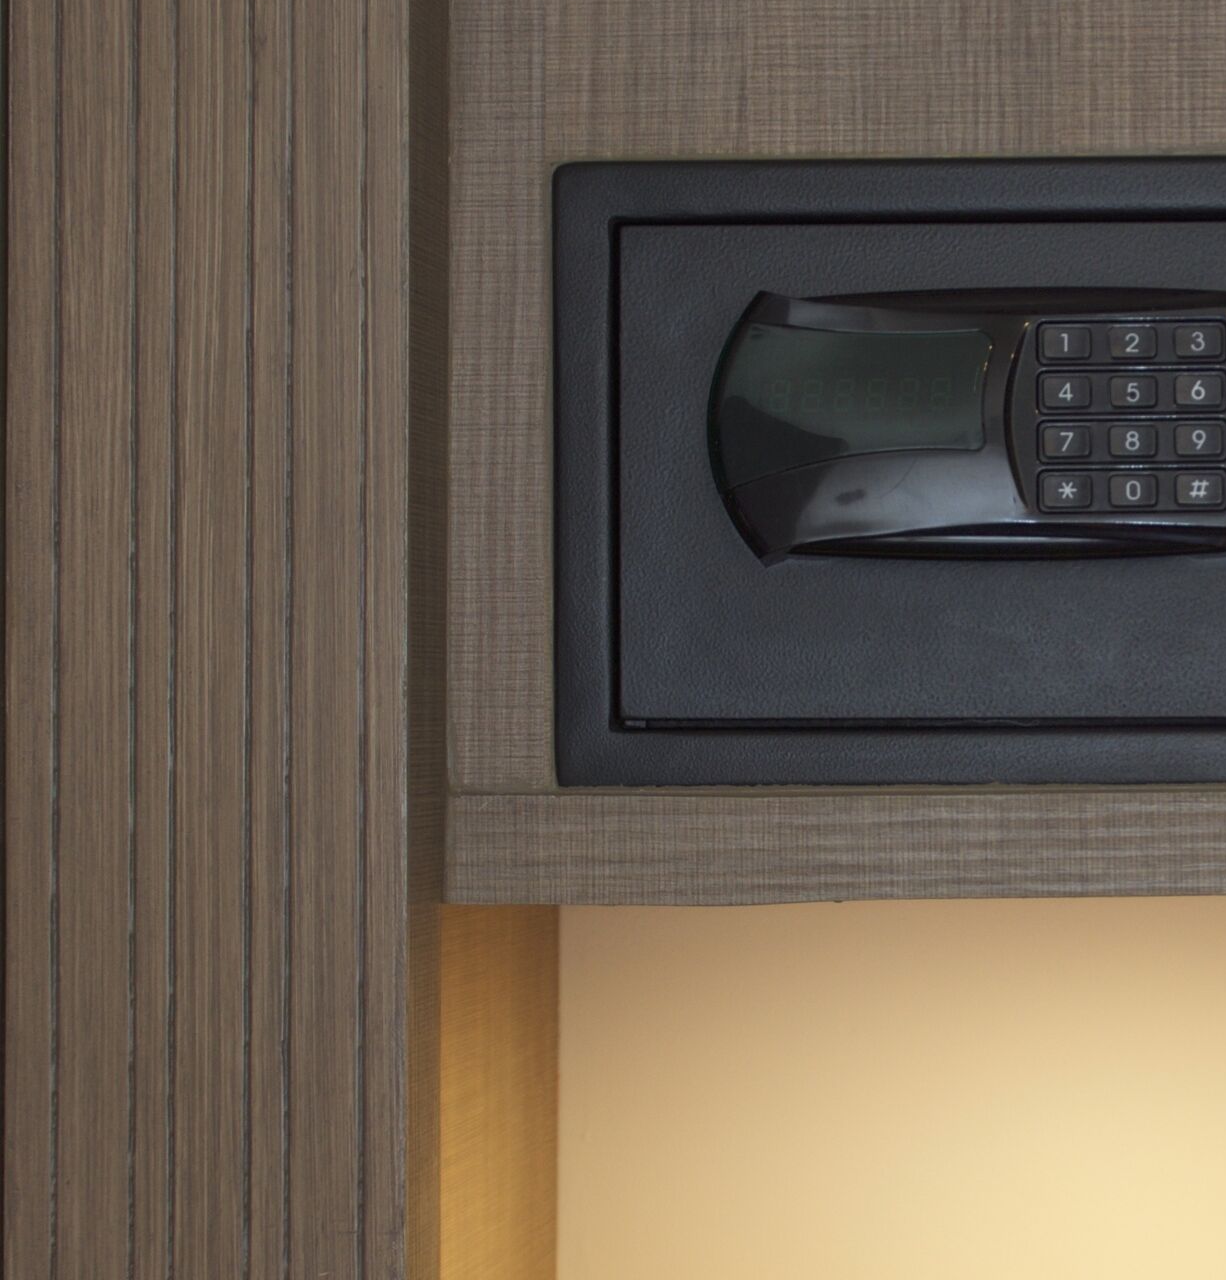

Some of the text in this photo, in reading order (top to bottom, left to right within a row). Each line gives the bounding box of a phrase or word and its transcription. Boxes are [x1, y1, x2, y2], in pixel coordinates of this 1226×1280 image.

[1060, 331, 1205, 353] 1 2 3
[1058, 380, 1206, 402] 4 5 6
[1060, 430, 1206, 452] 7 8 9
[1126, 480, 1141, 500] 0
